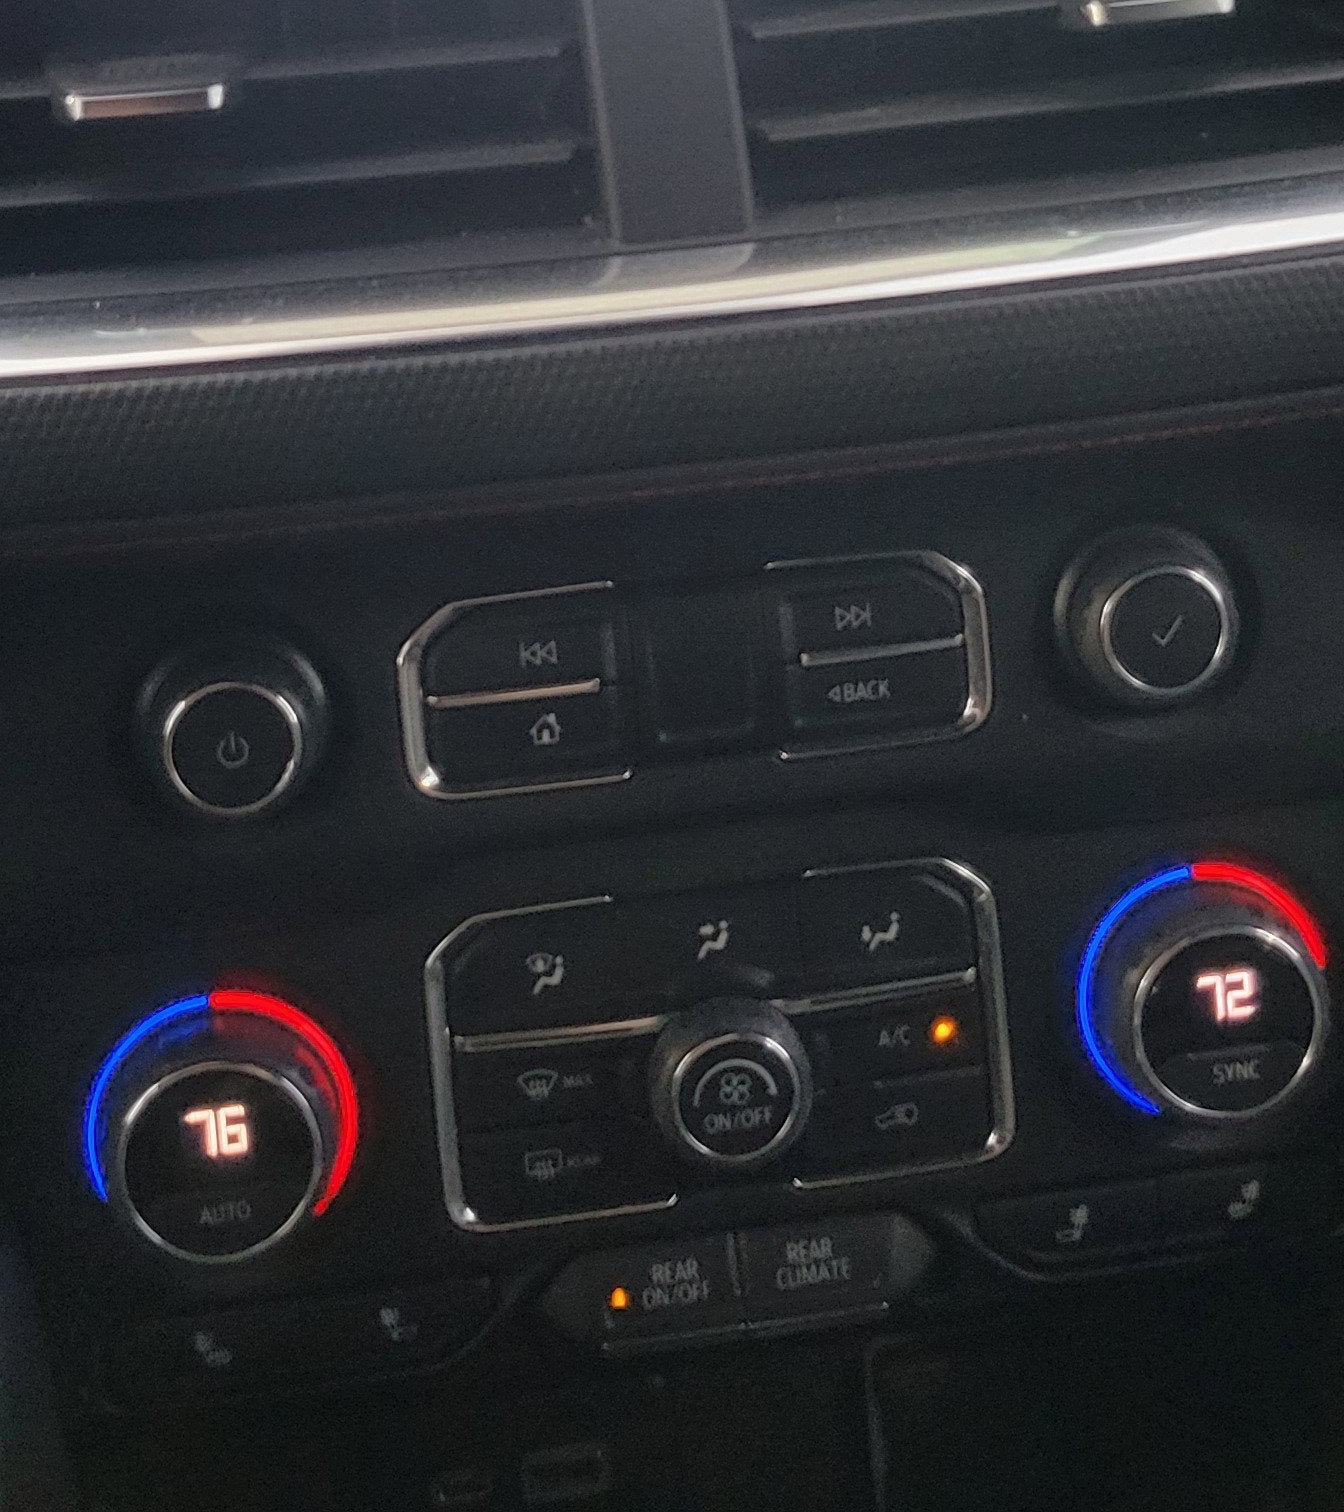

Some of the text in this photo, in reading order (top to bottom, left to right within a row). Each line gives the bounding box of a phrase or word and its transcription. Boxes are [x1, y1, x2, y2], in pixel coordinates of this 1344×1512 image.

[842, 677, 891, 703] BACK
[1196, 970, 1258, 1022] 72
[878, 1024, 911, 1048] A/C
[1212, 1060, 1261, 1086] SYNC
[184, 1103, 250, 1159] 76
[703, 1107, 774, 1133] ON/OFF
[198, 1199, 252, 1226] AUTO
[785, 1236, 833, 1261] REAR
[650, 1258, 700, 1284] REAR
[776, 1256, 851, 1285] CLIMATE
[642, 1279, 711, 1308] ON/OFF
